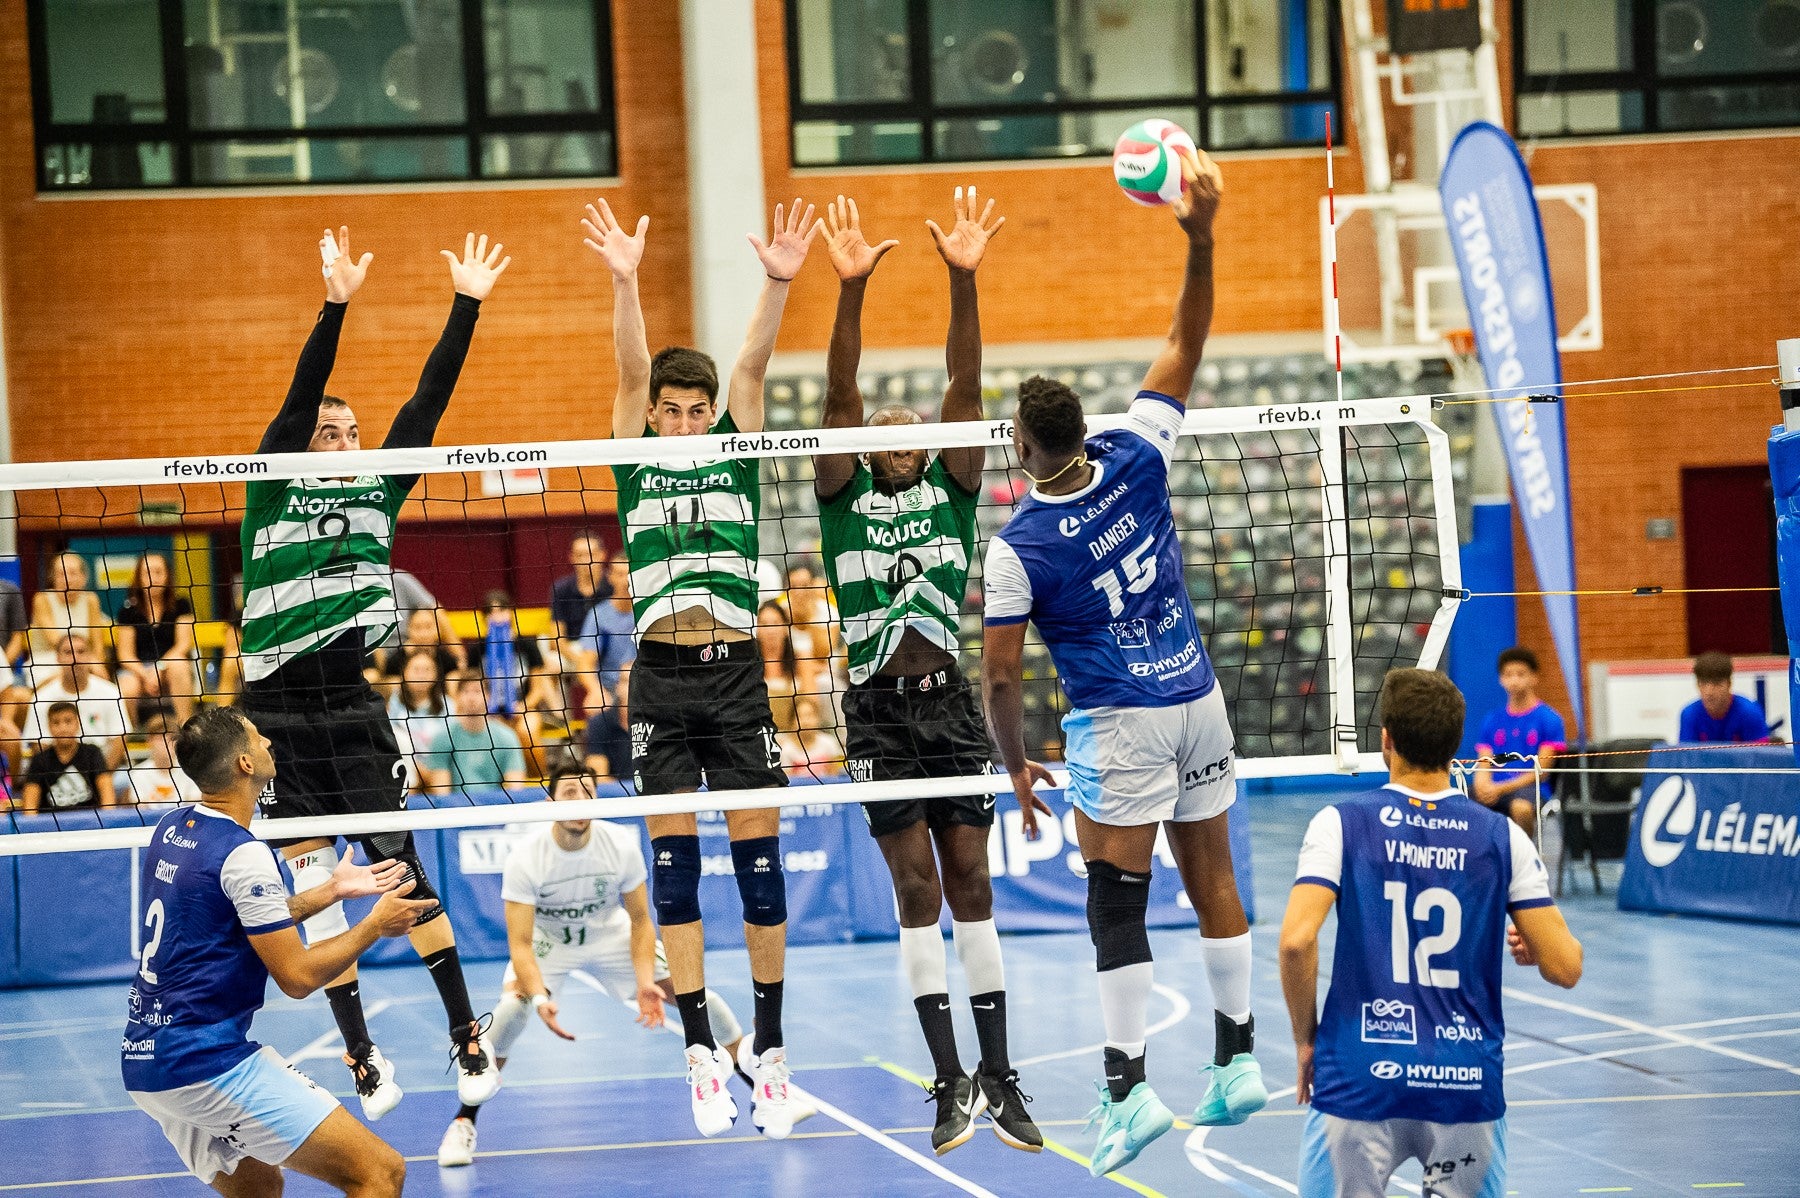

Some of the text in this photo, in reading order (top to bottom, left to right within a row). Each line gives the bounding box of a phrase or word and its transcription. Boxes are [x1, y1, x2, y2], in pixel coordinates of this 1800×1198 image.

[1258, 406, 1356, 424] rfevb.m
[721, 434, 820, 453] rfevb.com
[446, 447, 548, 466] rfevb.com
[164, 460, 268, 477] rfevb.com
[1081, 482, 1129, 523] LÉLEMAN
[317, 512, 358, 577] 2
[1088, 512, 1139, 561] DANGER
[1091, 533, 1158, 619] 15
[717, 643, 729, 660] 14
[935, 670, 947, 686] 10
[1405, 813, 1469, 831] LÉLEMAN
[1696, 801, 1800, 857] LÉLEM
[1384, 839, 1468, 871] V.MONFORT
[140, 898, 165, 985] 2
[1383, 880, 1463, 989] 12
[1366, 1019, 1413, 1034] SADIVAL
[1435, 1023, 1483, 1043] nexus
[1407, 1064, 1483, 1081] HYUNDAI
